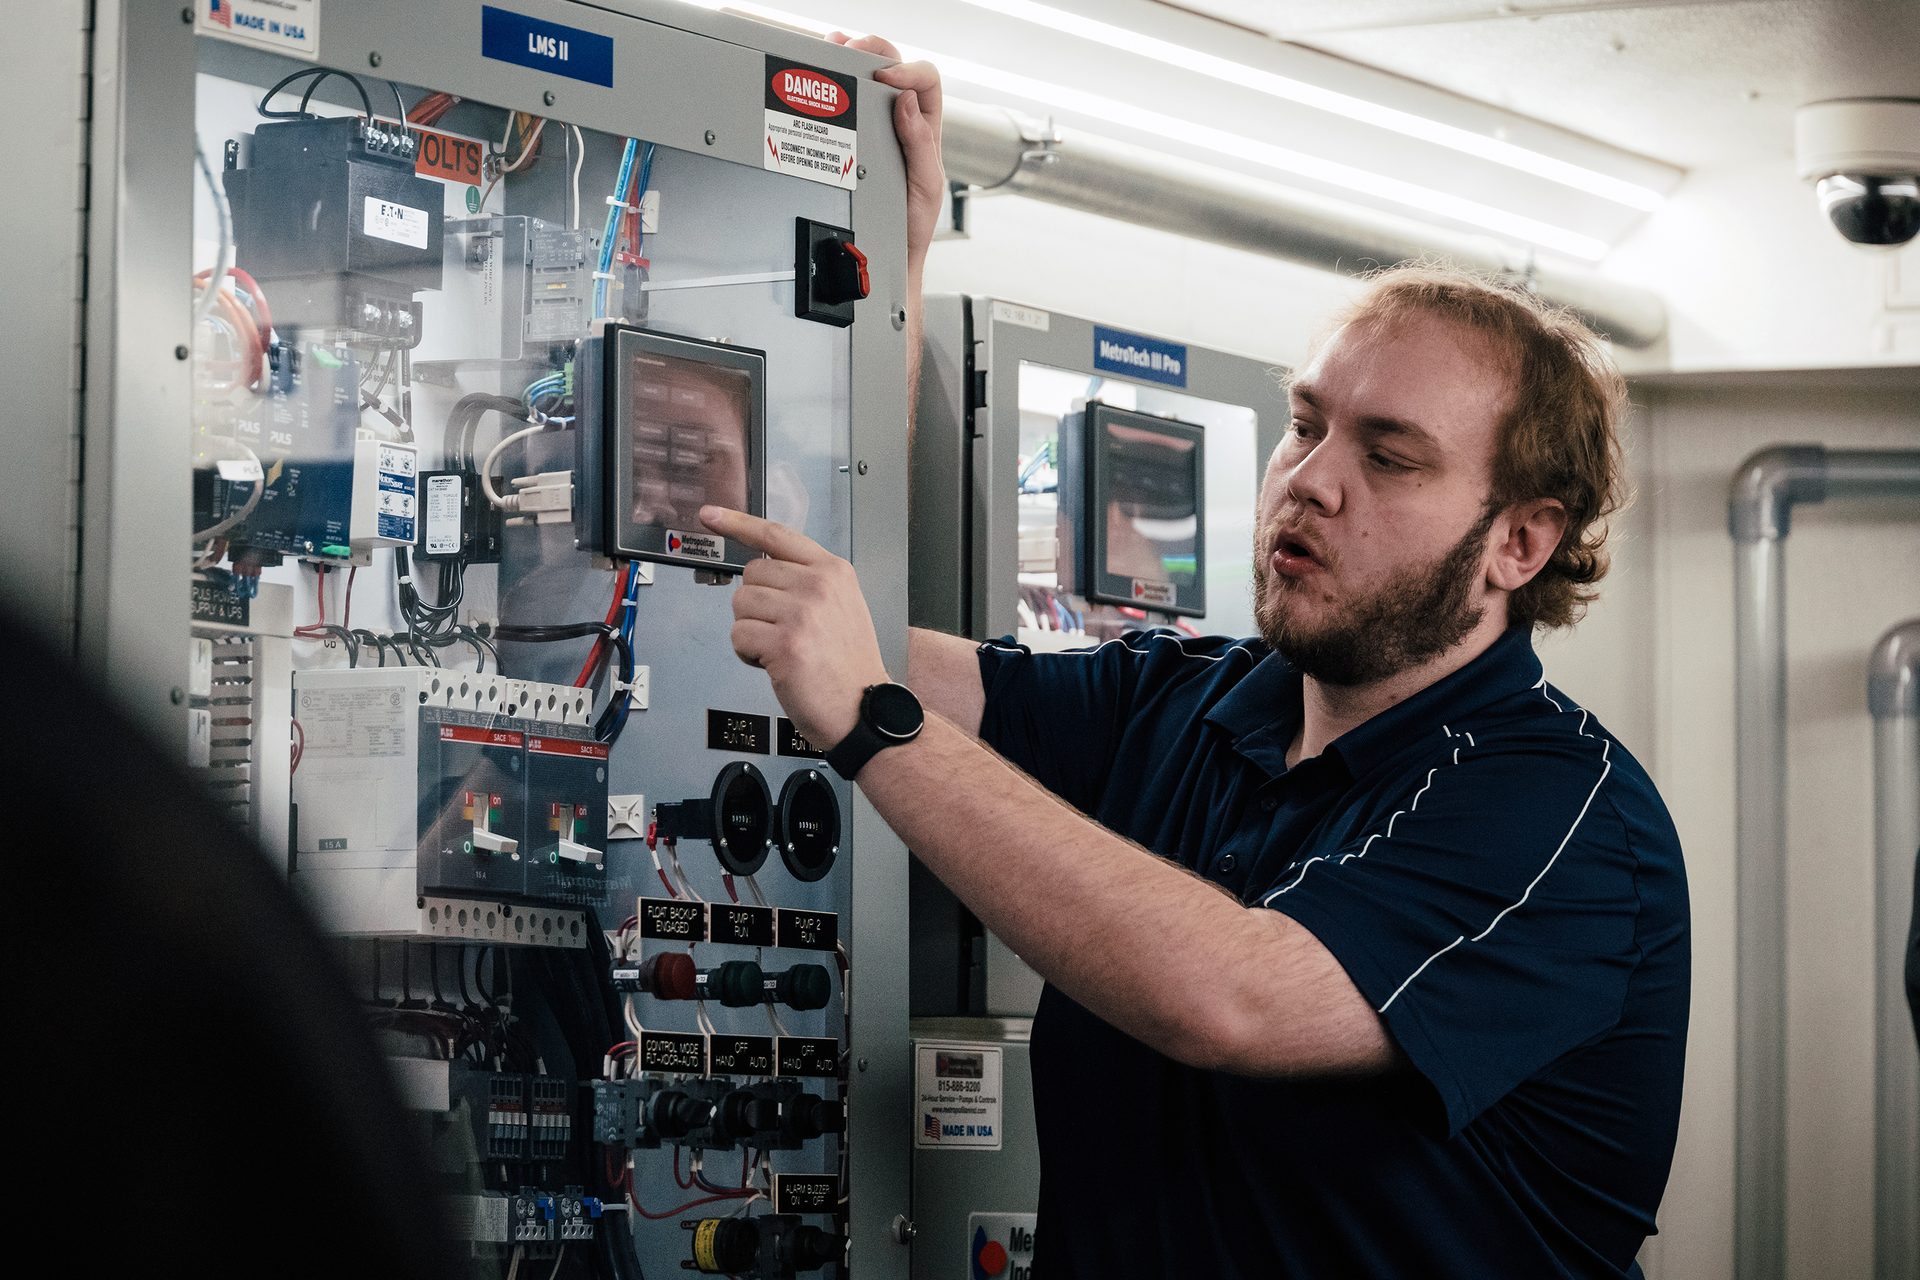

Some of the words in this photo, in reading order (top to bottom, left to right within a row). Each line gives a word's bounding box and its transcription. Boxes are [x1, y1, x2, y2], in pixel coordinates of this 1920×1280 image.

[234, 12, 264, 31] MADE
[268, 20, 280, 33] IN
[283, 23, 305, 40] USA
[528, 32, 556, 58] LMS
[559, 40, 568, 61] II
[784, 72, 838, 104] DANGER
[786, 94, 808, 106] ELECTRICAL
[808, 100, 822, 108] SHOCK
[822, 104, 836, 112] HAZARD
[768, 122, 788, 134] Appropriate
[788, 128, 802, 138] personal
[802, 132, 820, 142] protection
[820, 136, 838, 146] equipment
[792, 120, 801, 129] ARC
[802, 122, 814, 132] FLASH
[814, 124, 829, 136] HAZARD
[781, 140, 806, 154] DISCONNECT
[806, 148, 826, 160] INCOMING
[826, 152, 840, 164] POWER
[780, 152, 796, 164] BEFORE
[796, 156, 814, 168] OPENING
[814, 160, 820, 170] OR
[820, 161, 841, 174] SERVICING
[1100, 340, 1150, 368] MetroTech
[1150, 352, 1162, 370] III
[1162, 354, 1180, 376] Pro
[238, 420, 260, 434] PULS
[270, 430, 292, 445] PULS
[682, 534, 715, 547] Metropolitan
[682, 545, 710, 558] Industries,
[710, 549, 720, 558] Inc.
[192, 586, 211, 600] PULS
[214, 590, 240, 604] POWER
[192, 600, 217, 615] SUPPLY
[219, 605, 225, 616] &
[228, 607, 243, 619] UPS
[727, 718, 747, 731] PUMP
[749, 721, 753, 731] 1
[440, 728, 454, 738] ABB
[493, 734, 506, 742] SACE
[508, 734, 521, 743] Tmax
[723, 731, 738, 744] RUN
[740, 733, 756, 747] TIME
[528, 739, 542, 749] ABB
[580, 746, 592, 754] SACE
[791, 738, 806, 750] RUN
[492, 796, 502, 804] on
[579, 806, 587, 816] on
[648, 905, 668, 918] FLOAT
[670, 907, 698, 920] BACKUP
[729, 911, 749, 924] PUMP
[751, 914, 755, 925] 1
[656, 920, 690, 934] ENGAGED
[795, 916, 814, 929] PUMP
[816, 918, 821, 930] 2
[734, 925, 749, 938] RUN
[801, 931, 815, 943] RUN
[646, 1040, 677, 1053] CONTROL
[680, 1043, 699, 1055] MODE
[734, 1042, 748, 1054] OFF
[802, 1045, 814, 1056] OFF
[716, 1055, 735, 1067] HAND
[750, 1056, 767, 1068] AUTO
[783, 1058, 801, 1069] HAND
[816, 1060, 833, 1070] AUTO
[938, 1080, 980, 1092] 815-886-9200
[940, 1094, 955, 1102] Service
[959, 1095, 974, 1104] Pumps
[942, 1125, 964, 1136] MADE
[966, 1126, 975, 1136] IN
[976, 1126, 993, 1136] USA
[786, 1184, 806, 1194] ALARM
[807, 1184, 830, 1194] BUZZER
[791, 1195, 800, 1206] ON
[813, 1195, 824, 1206] OFF
